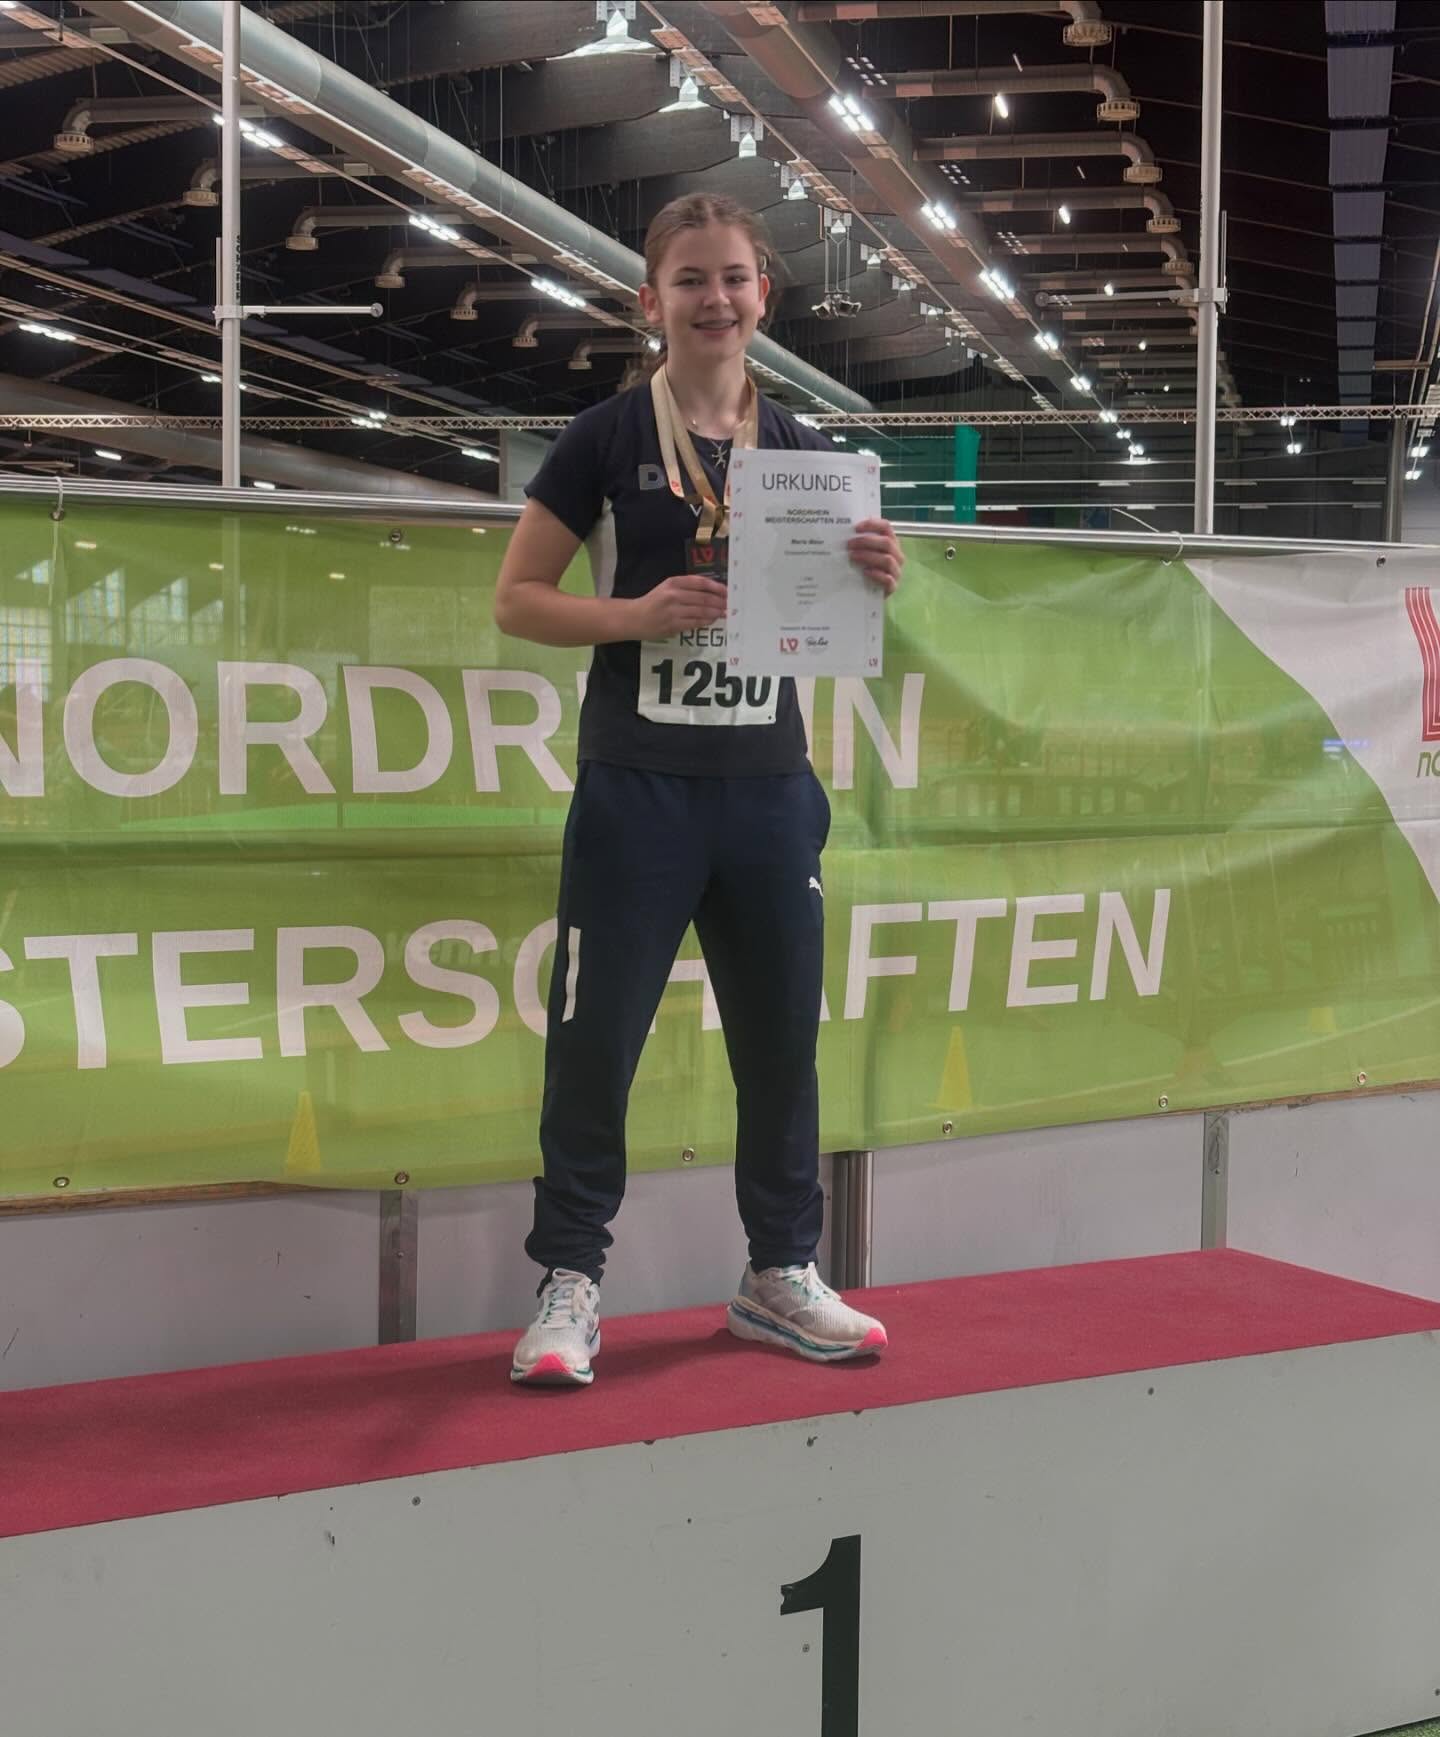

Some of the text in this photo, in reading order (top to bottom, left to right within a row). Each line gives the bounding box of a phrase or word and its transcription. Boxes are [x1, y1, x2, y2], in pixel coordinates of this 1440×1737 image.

[762, 473, 853, 492] URKUNDE
[765, 516, 834, 525] MEISTERSCHAFTEN
[786, 509, 830, 517] NORDRHEIN
[680, 627, 728, 647] REG
[652, 658, 771, 708] 1250
[779, 1534, 861, 1737] 1
